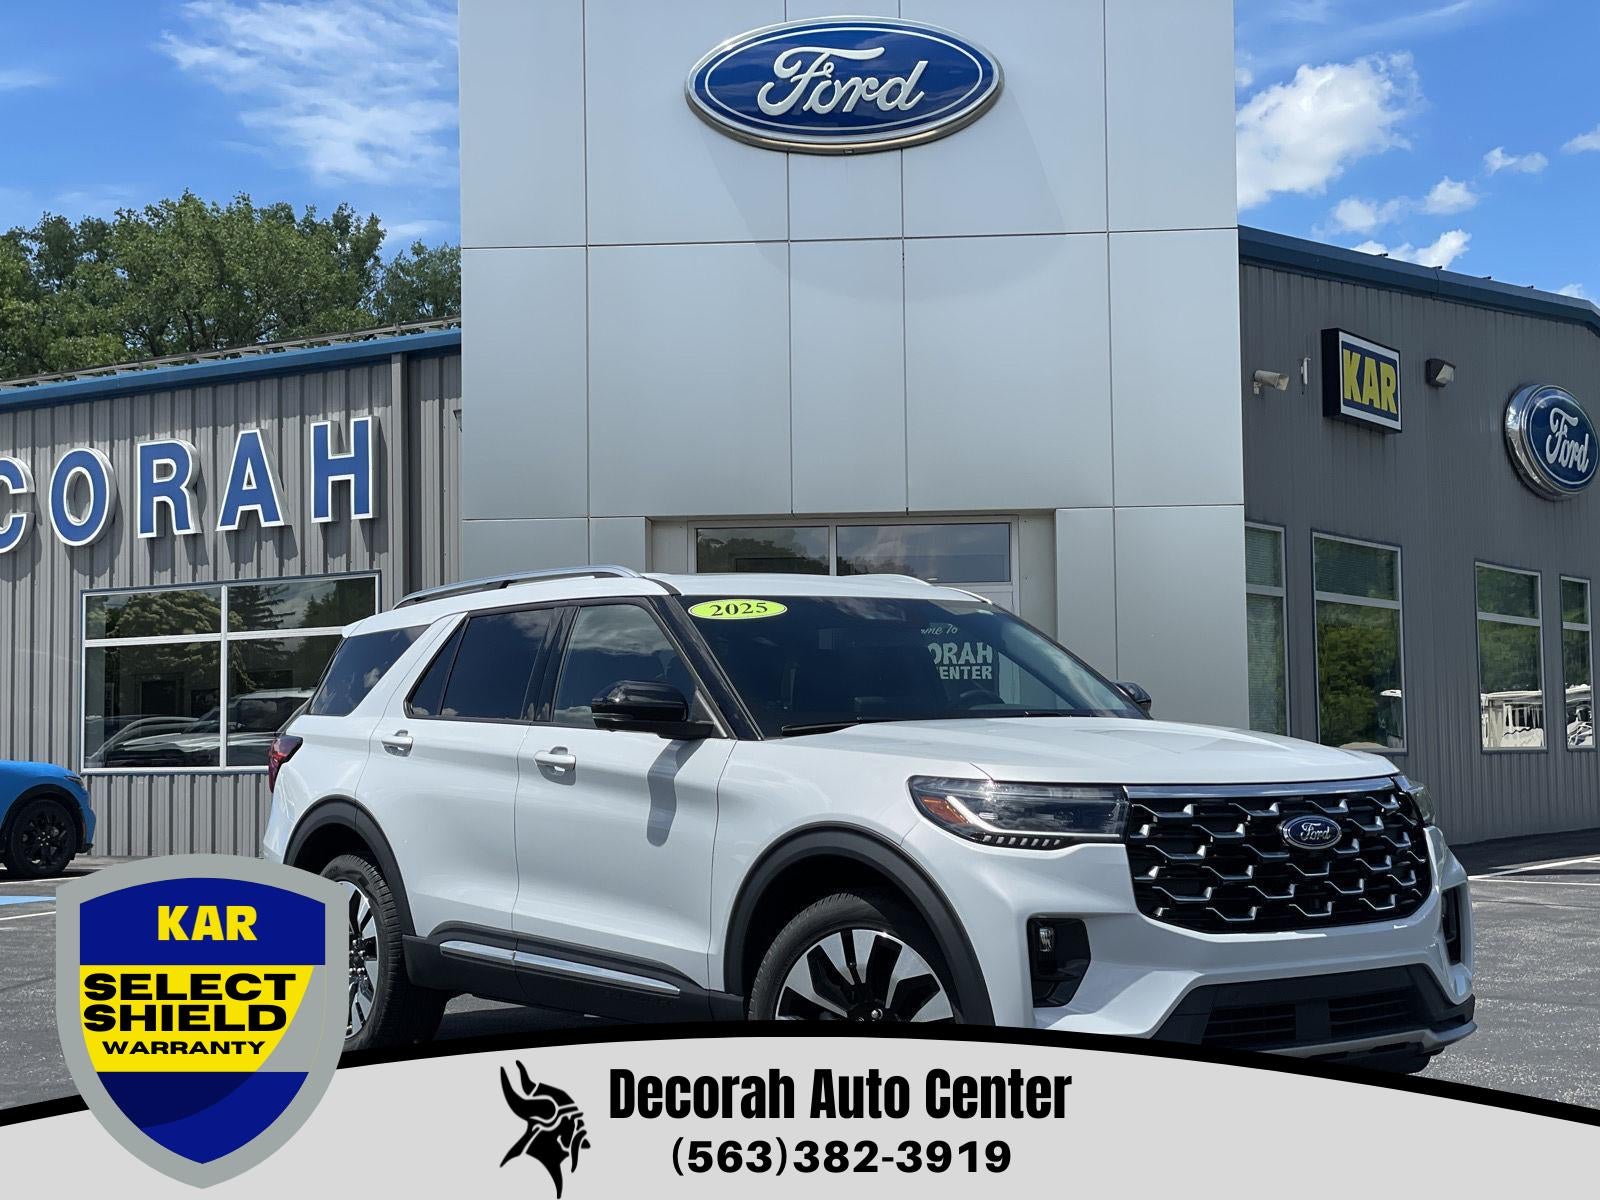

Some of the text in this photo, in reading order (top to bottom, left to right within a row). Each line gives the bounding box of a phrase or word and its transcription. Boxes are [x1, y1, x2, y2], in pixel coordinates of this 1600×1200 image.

[757, 46, 929, 116] Ford
[1343, 349, 1398, 415] KAR
[1545, 407, 1590, 473] Ford
[709, 602, 768, 616] 2025
[936, 665, 993, 680] ENTER
[1300, 822, 1331, 841] Ford
